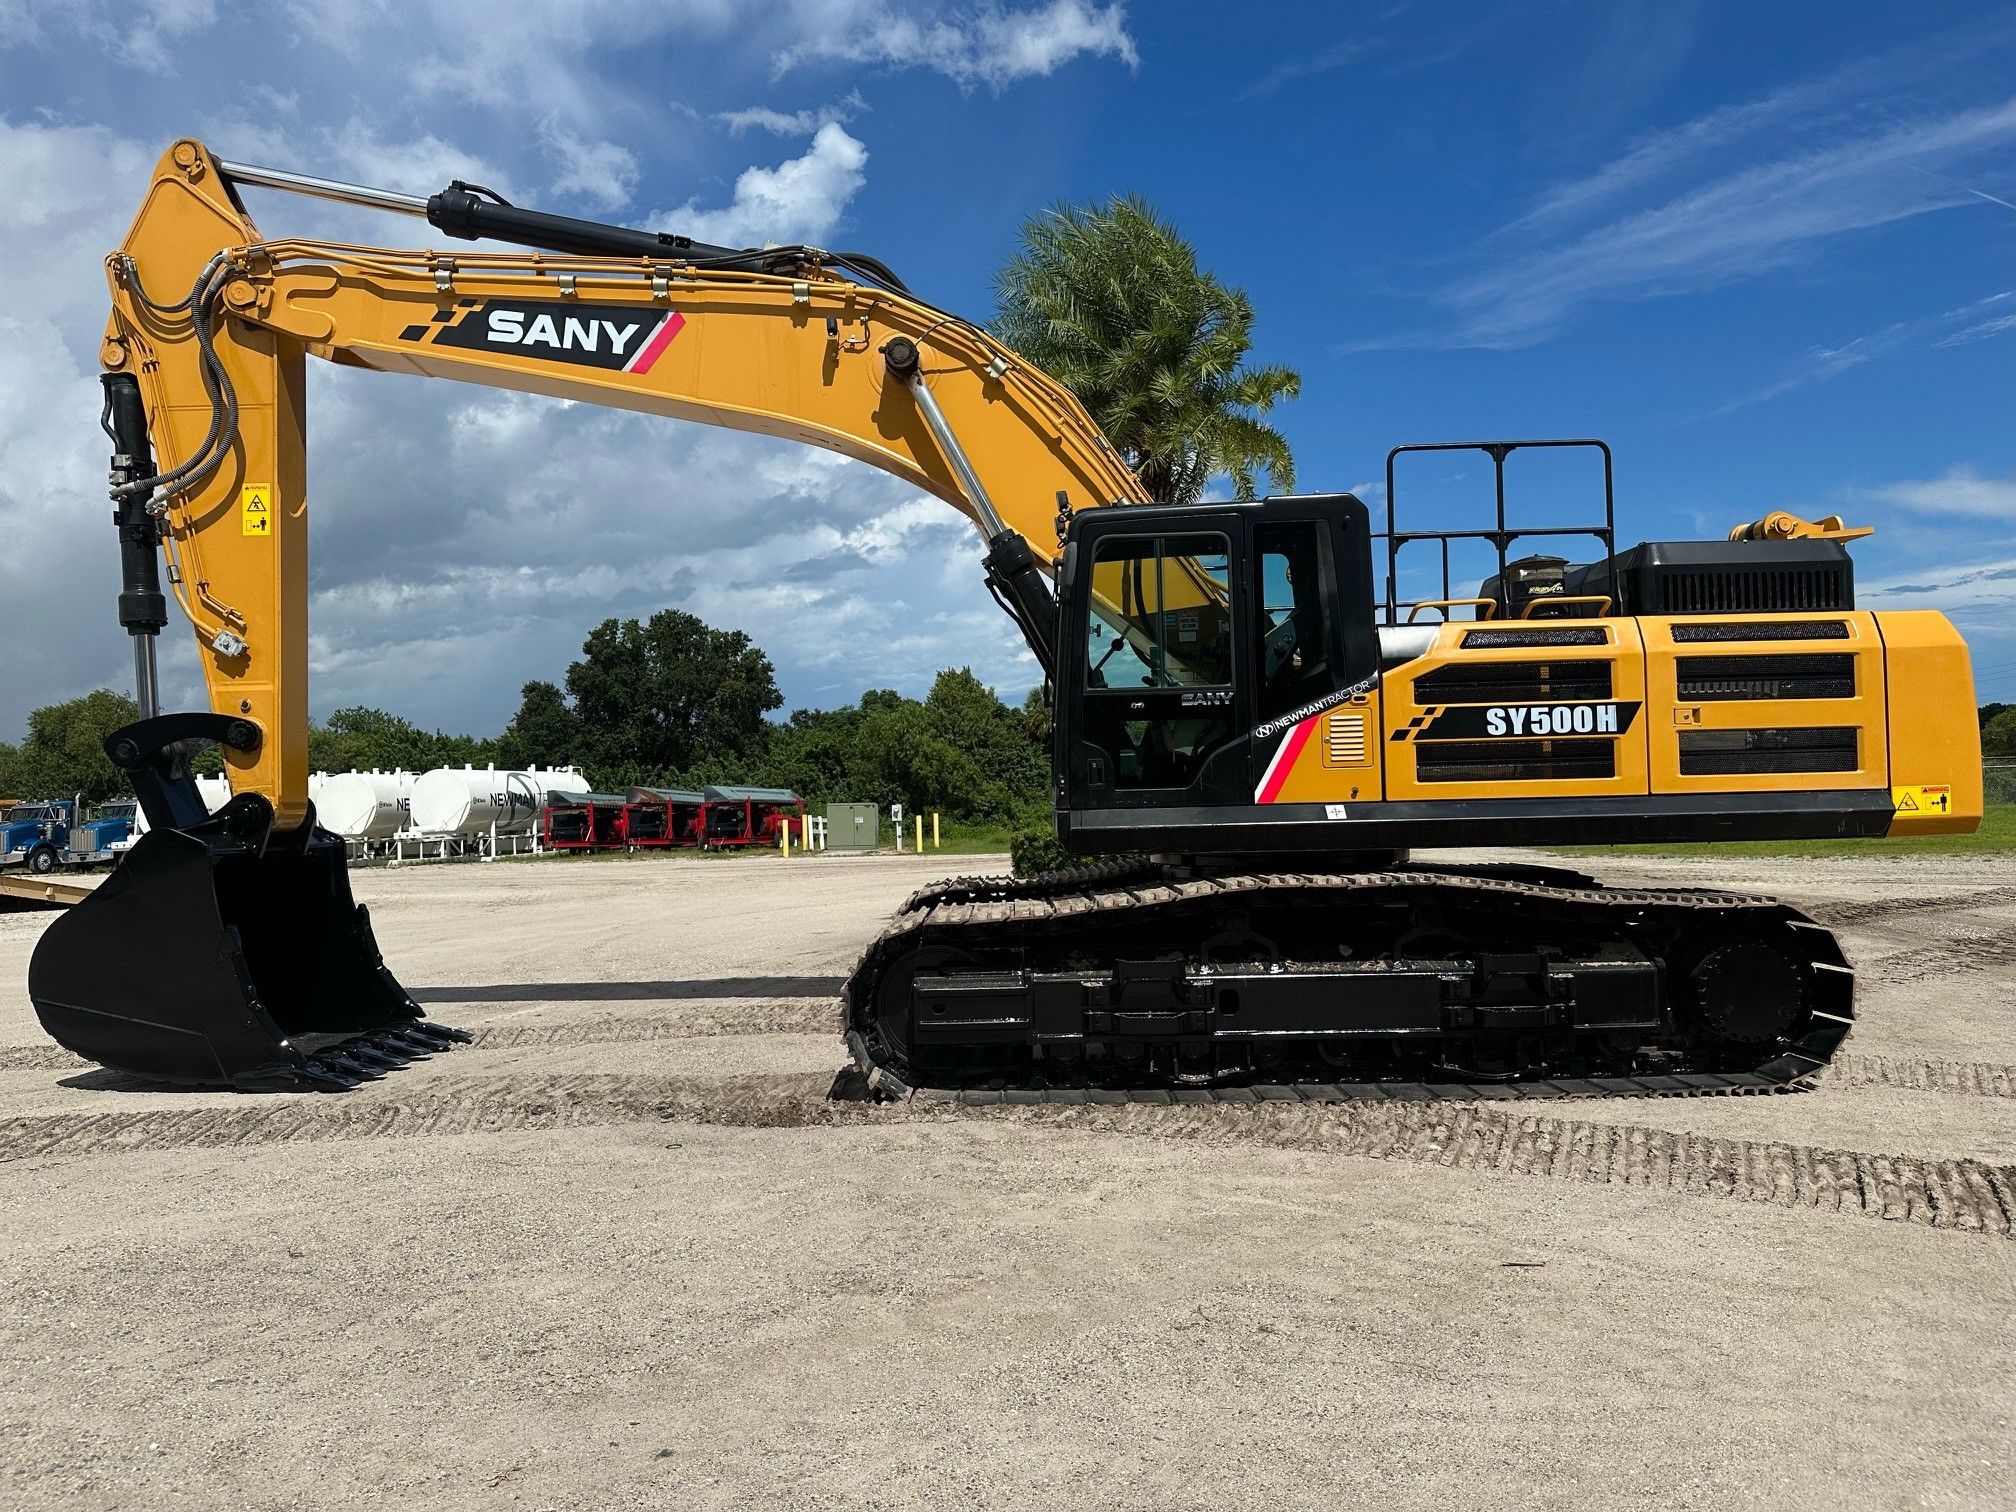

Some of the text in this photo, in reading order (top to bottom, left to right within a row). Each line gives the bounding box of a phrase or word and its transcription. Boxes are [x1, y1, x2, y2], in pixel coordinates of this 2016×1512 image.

[487, 309, 640, 355] SANY
[1181, 692, 1235, 706] SANY
[1486, 704, 1618, 736] SY500H
